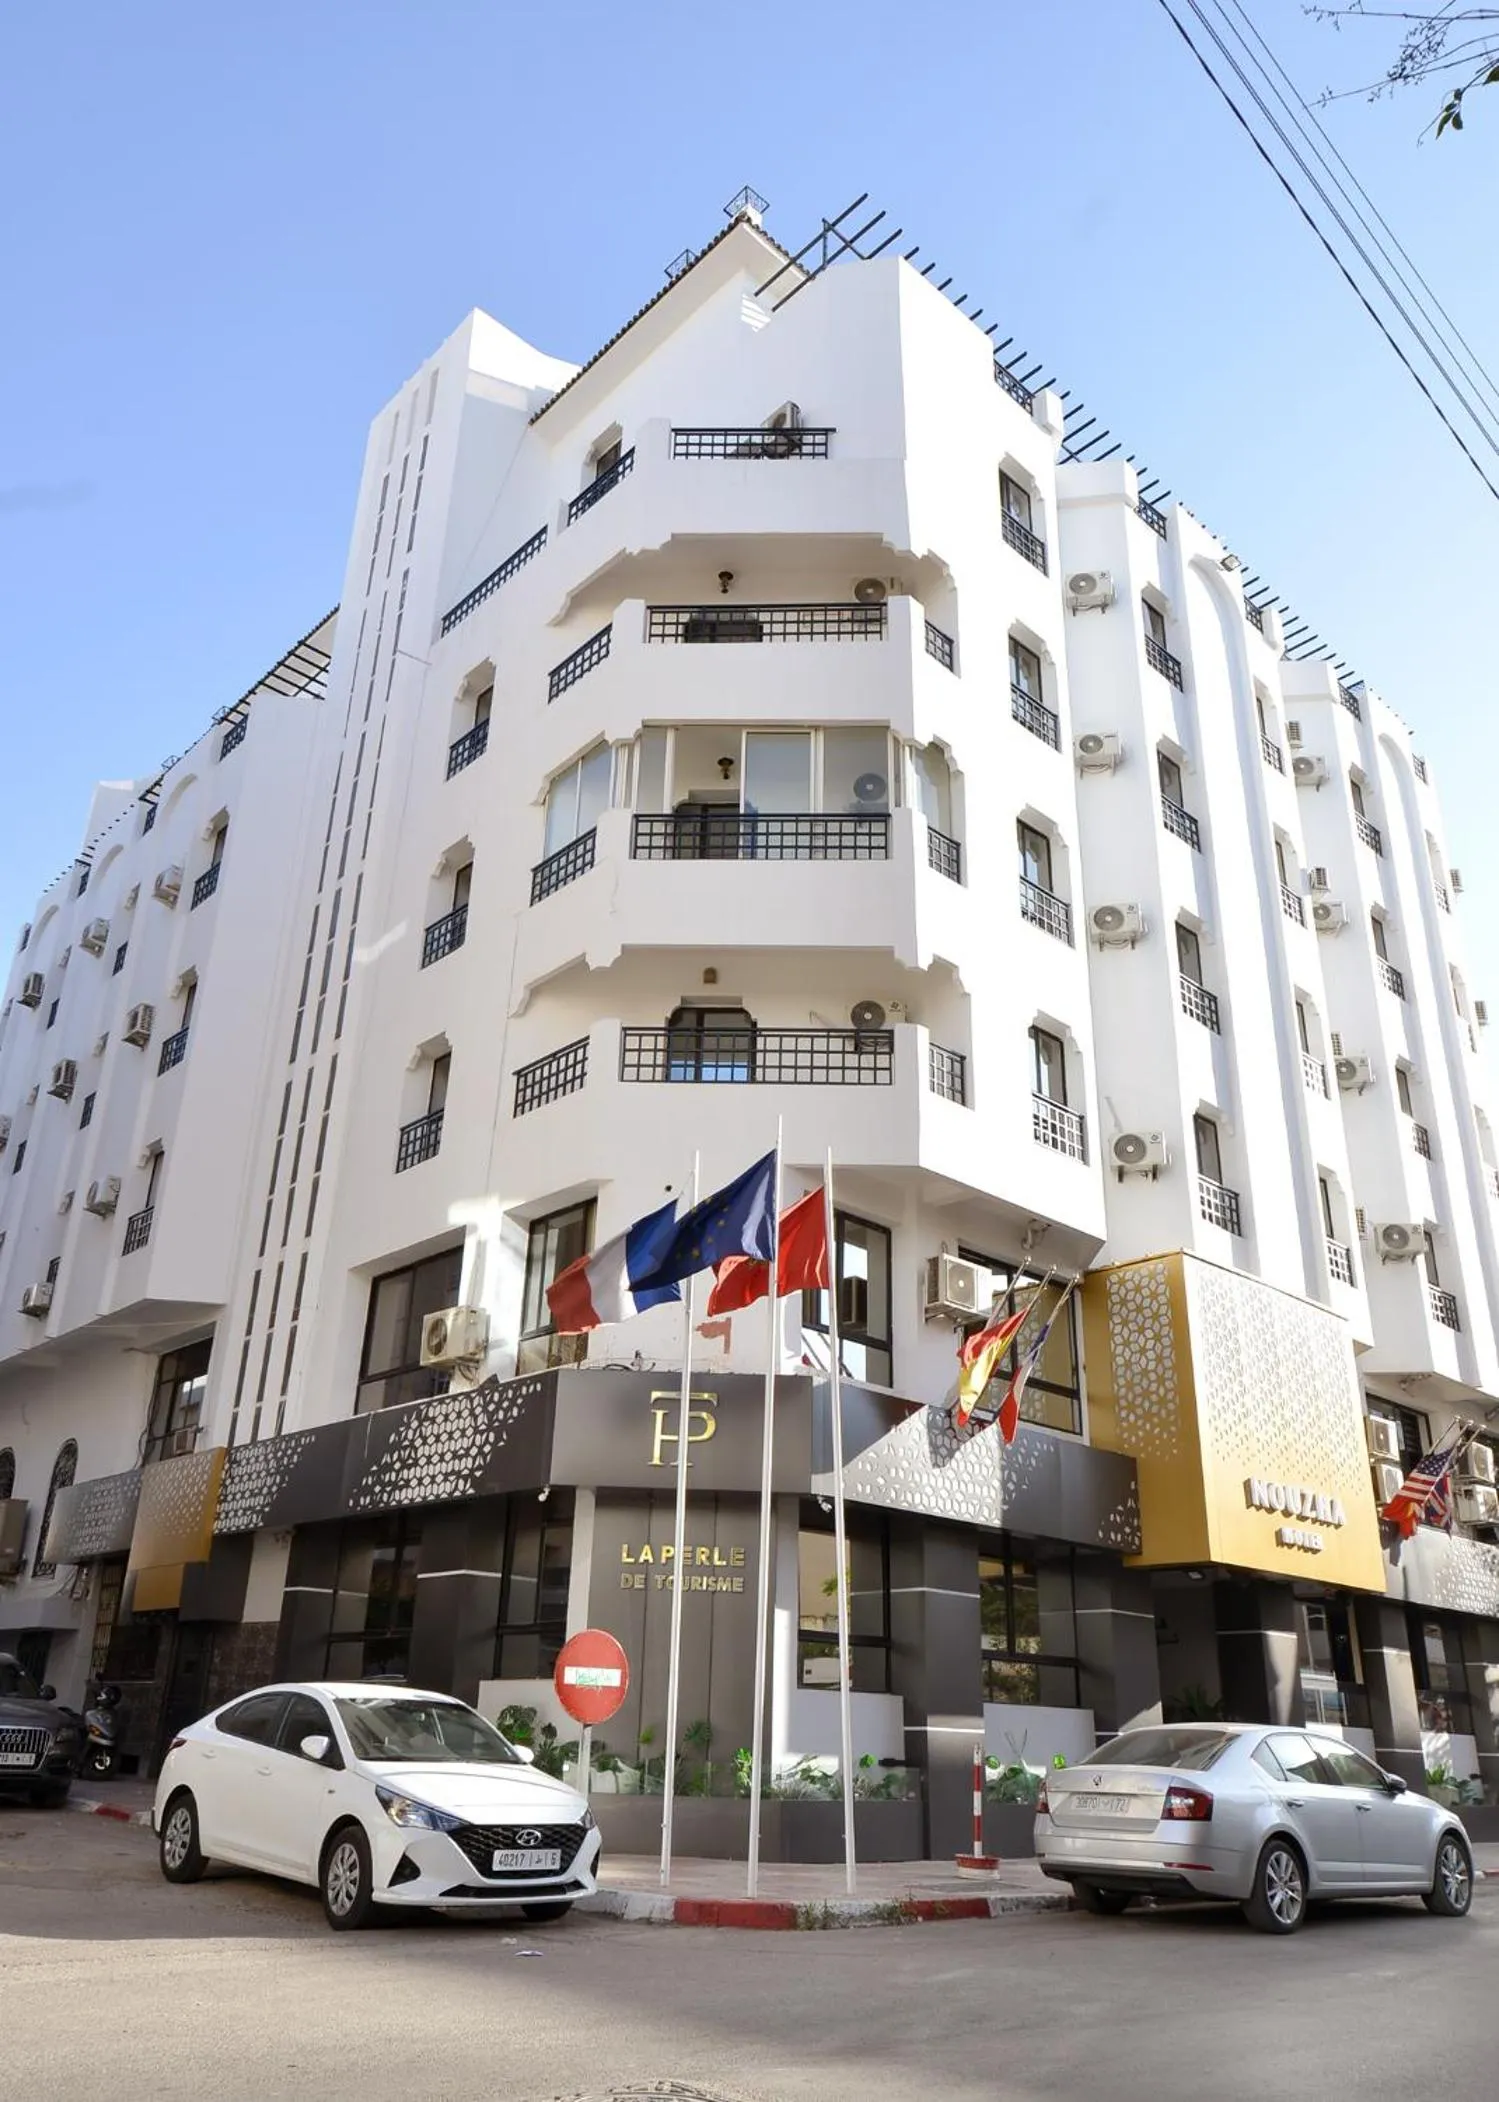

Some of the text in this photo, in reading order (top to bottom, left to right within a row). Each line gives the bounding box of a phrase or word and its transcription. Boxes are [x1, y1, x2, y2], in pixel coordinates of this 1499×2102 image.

[621, 1543, 745, 1566] LA PERLE
[620, 1572, 745, 1593] DE TOURISME
